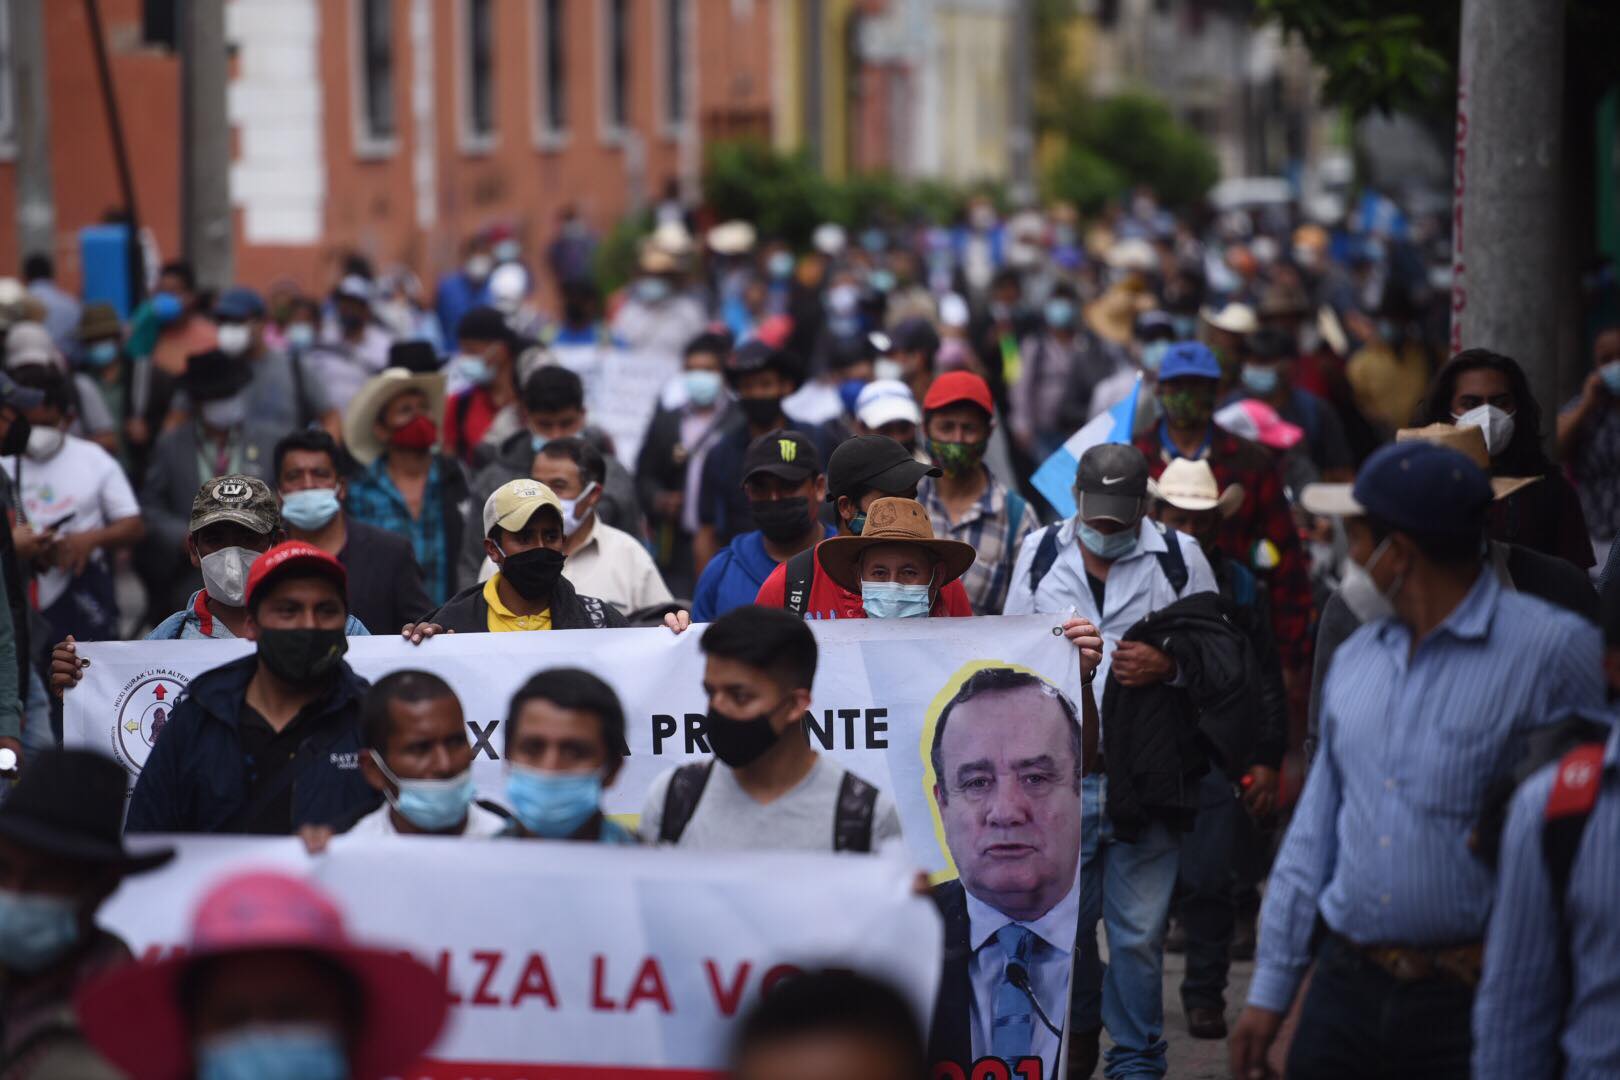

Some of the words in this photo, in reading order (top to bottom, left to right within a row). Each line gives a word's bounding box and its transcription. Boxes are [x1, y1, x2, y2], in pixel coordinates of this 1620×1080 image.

[168, 670, 189, 682] ALTEP
[652, 708, 889, 755] PRNTE
[591, 954, 674, 1015] LA
